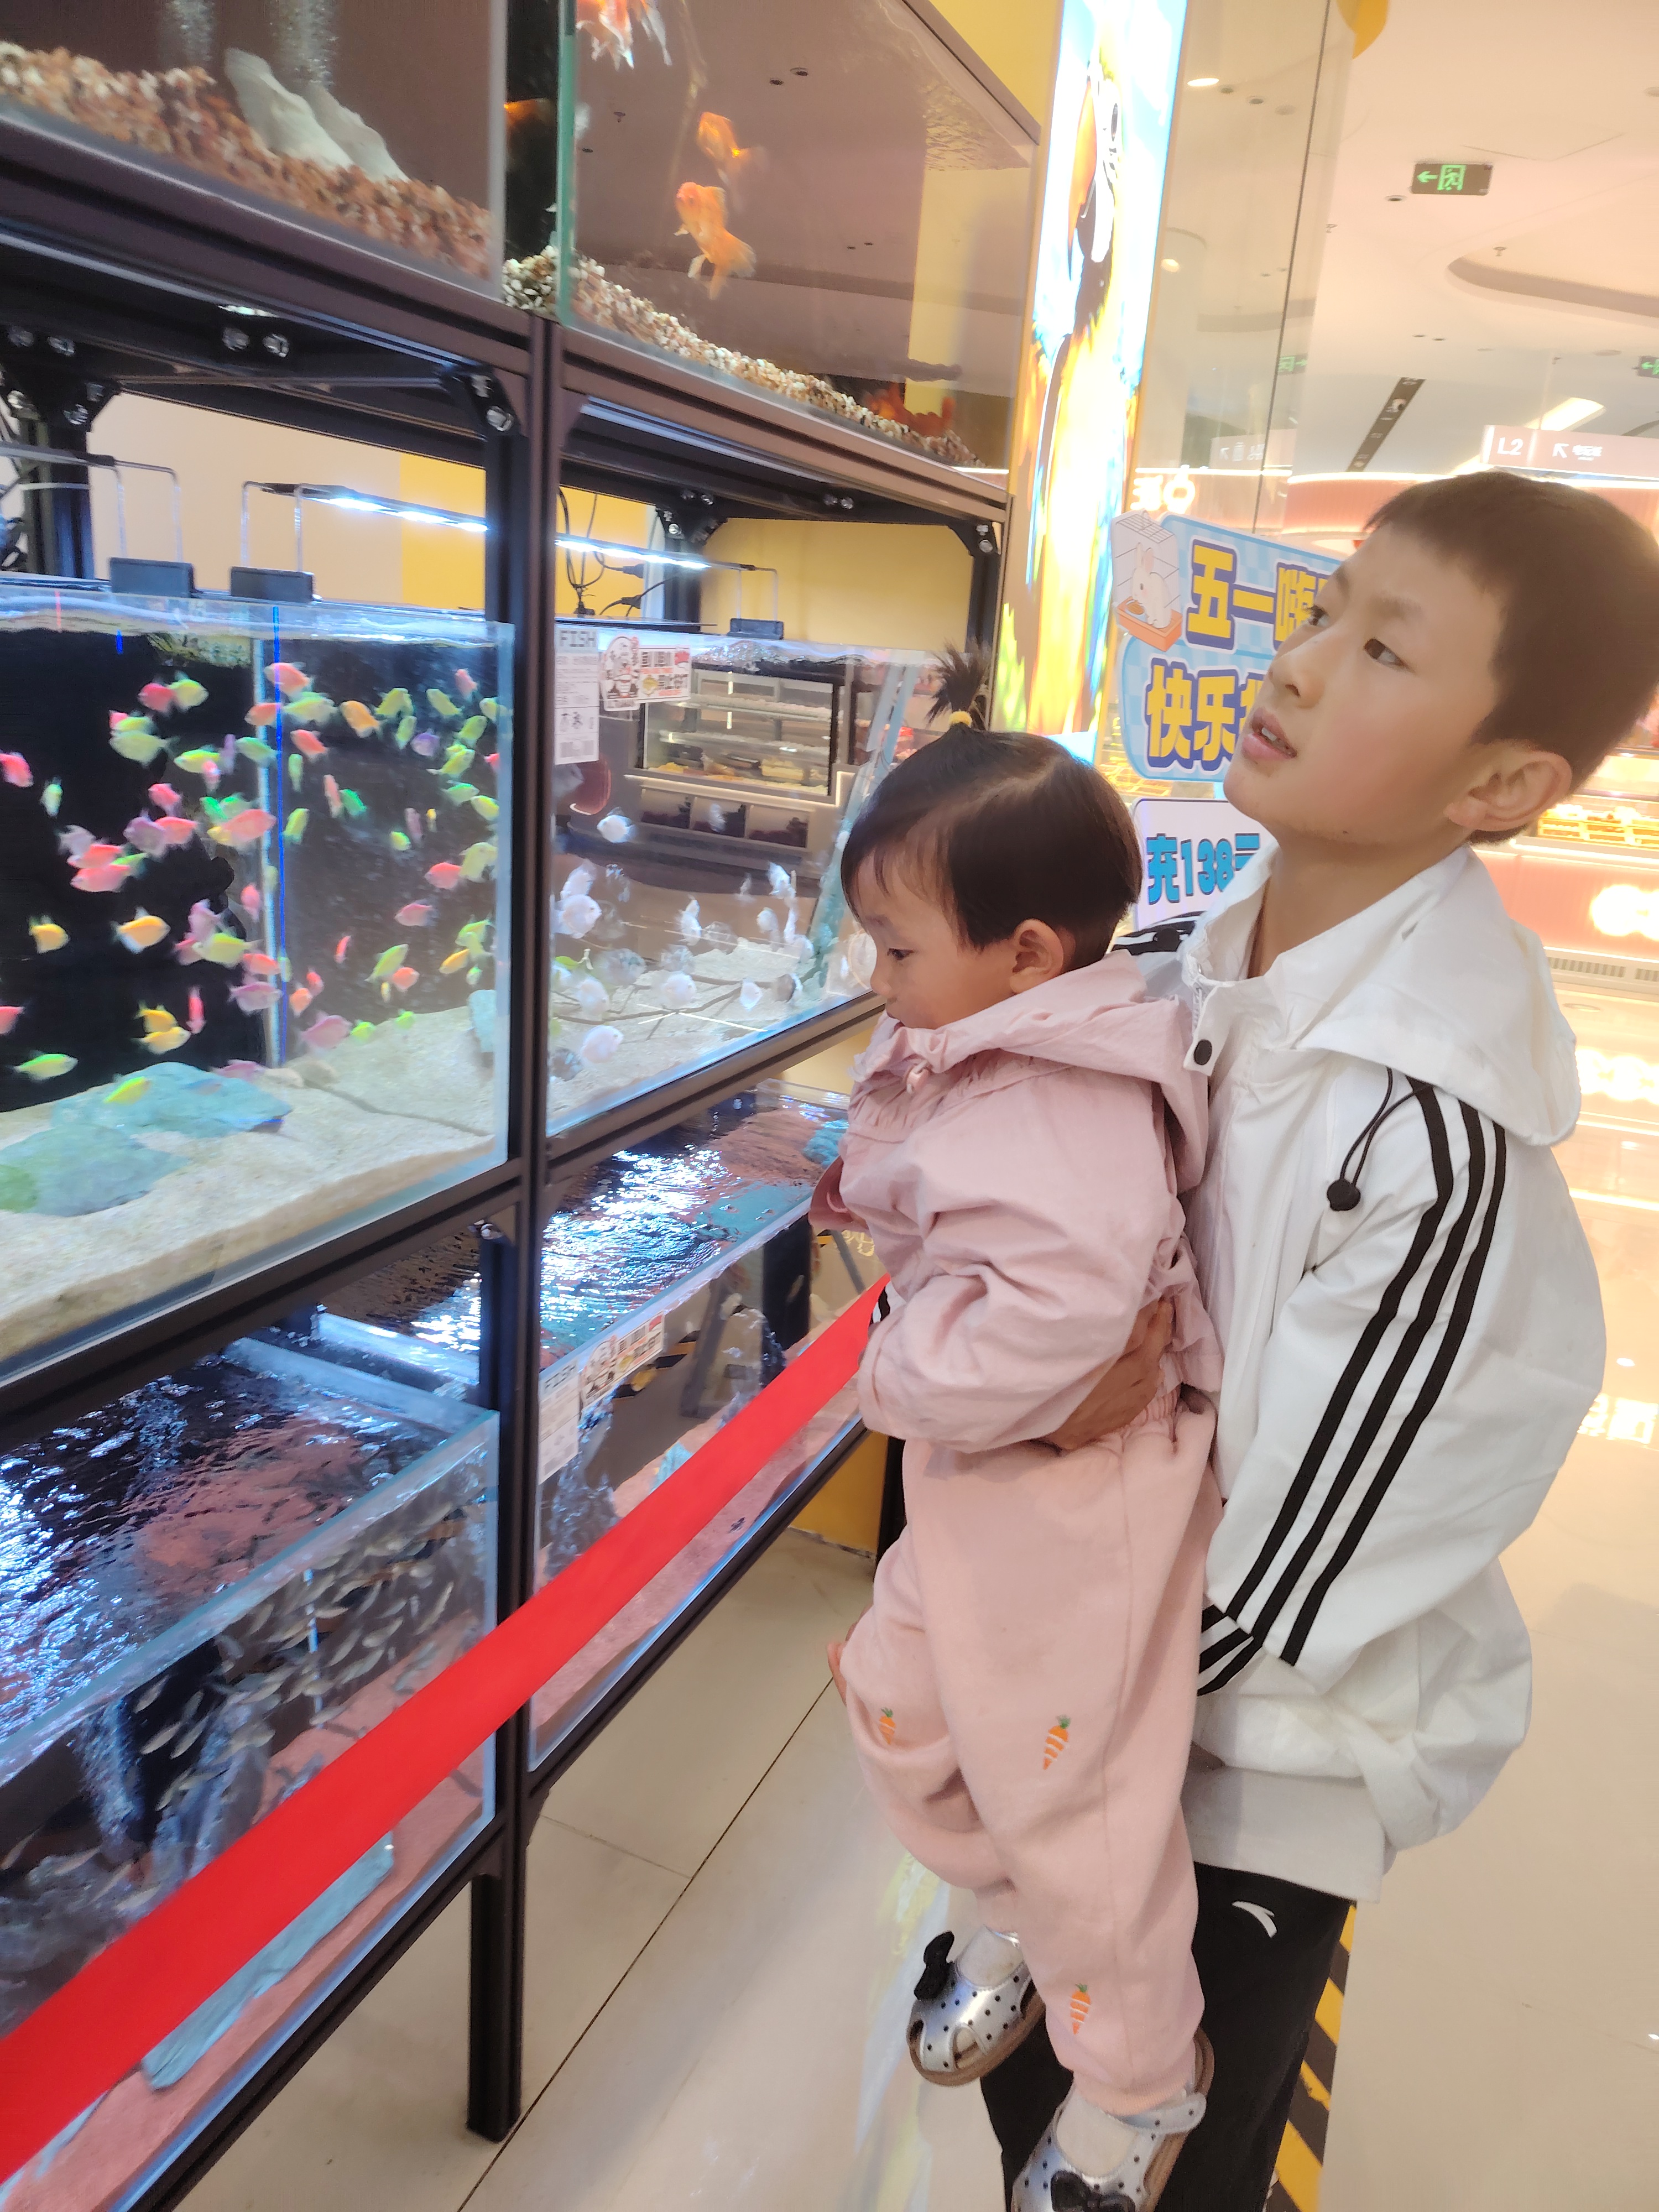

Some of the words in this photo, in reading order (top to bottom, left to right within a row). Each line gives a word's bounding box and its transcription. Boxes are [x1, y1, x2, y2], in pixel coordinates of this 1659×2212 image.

[1497, 437, 1524, 455] L2
[1187, 542, 1328, 643] 五一嗨
[560, 630, 597, 648] FISH
[1146, 664, 1264, 761] 快乐
